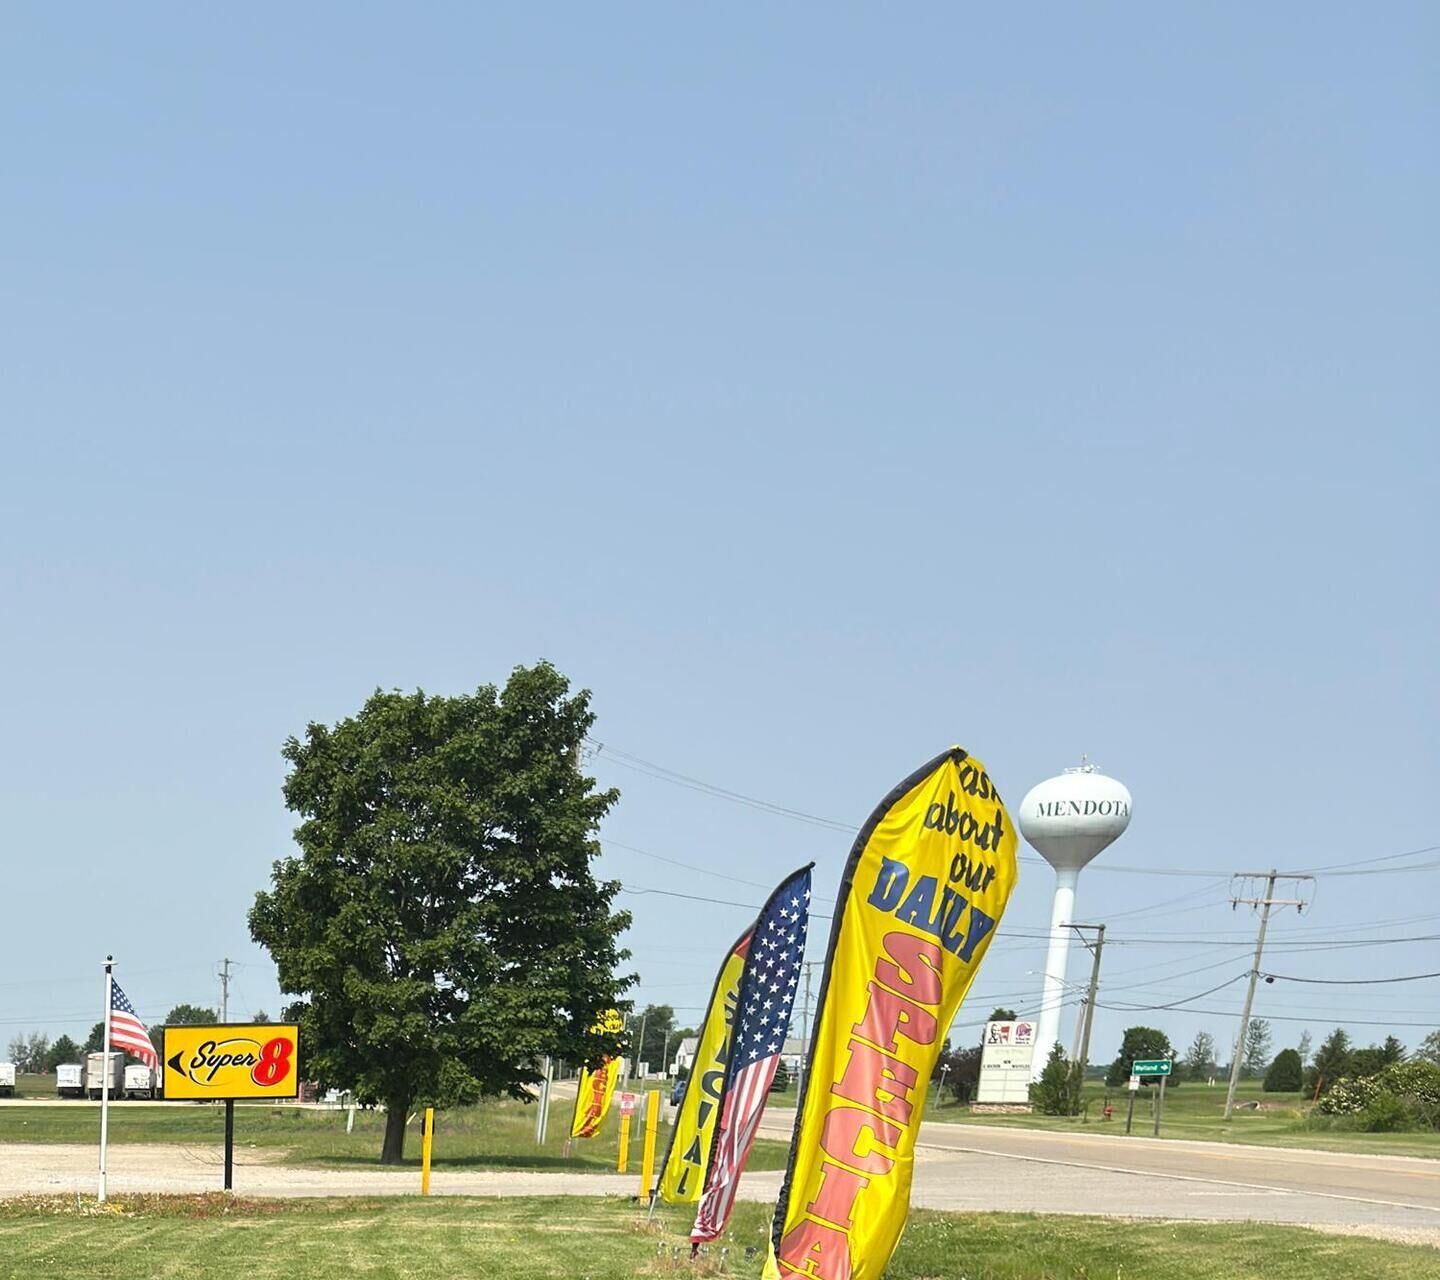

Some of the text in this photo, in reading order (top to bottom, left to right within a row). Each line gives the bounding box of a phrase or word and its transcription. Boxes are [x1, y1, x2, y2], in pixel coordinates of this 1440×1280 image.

[924, 790, 1004, 852] about
[1036, 800, 1129, 818] MENDOTA
[950, 853, 995, 894] our
[867, 855, 995, 964] DAILY
[190, 1037, 293, 1086] Super 8
